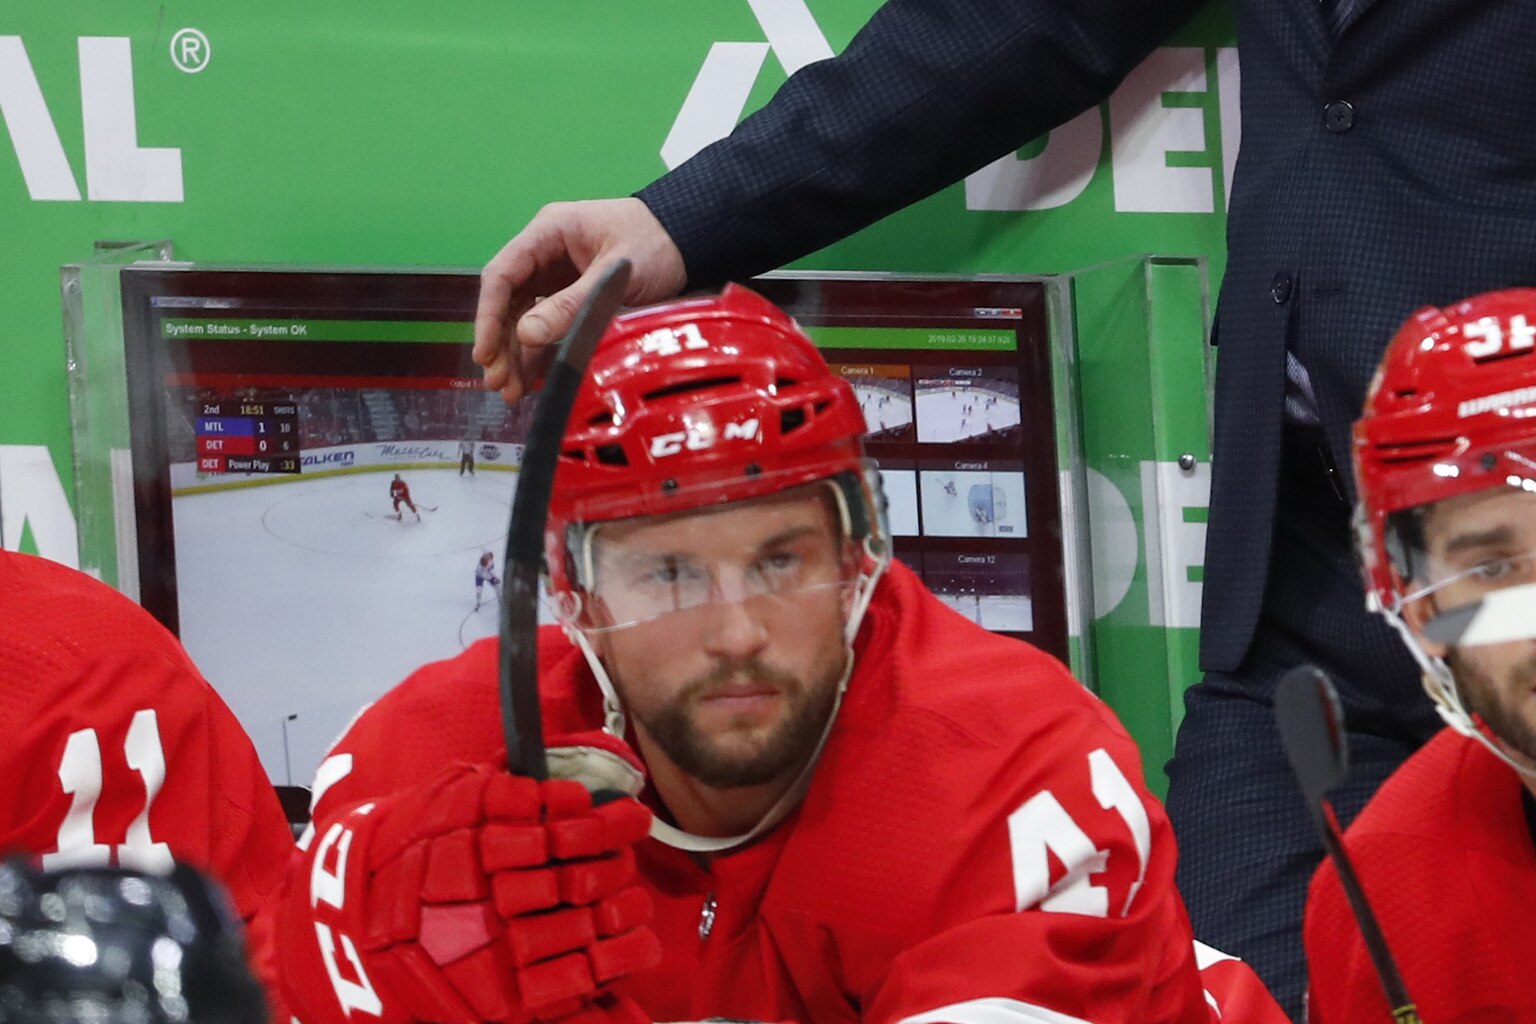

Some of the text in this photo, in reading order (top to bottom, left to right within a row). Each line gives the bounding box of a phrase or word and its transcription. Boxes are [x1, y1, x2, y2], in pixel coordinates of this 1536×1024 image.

[166, 323, 204, 335] System
[207, 324, 241, 334] Status
[250, 324, 288, 336] System
[291, 325, 308, 335] OK
[642, 323, 709, 356] 41
[841, 366, 874, 375] Camera 1
[949, 367, 983, 377] Camera 2
[450, 380, 470, 388] Output
[203, 405, 220, 414] 2nd
[204, 422, 224, 432] MTL
[259, 422, 265, 433] 1
[206, 440, 223, 450] DET
[259, 440, 267, 451] 0
[202, 459, 219, 468] DET
[228, 460, 251, 469] Power
[253, 460, 270, 472] Play
[955, 461, 988, 470] Camera 4
[958, 555, 995, 564] Camera 12
[43, 709, 176, 875] 11
[1008, 748, 1152, 918] 41
